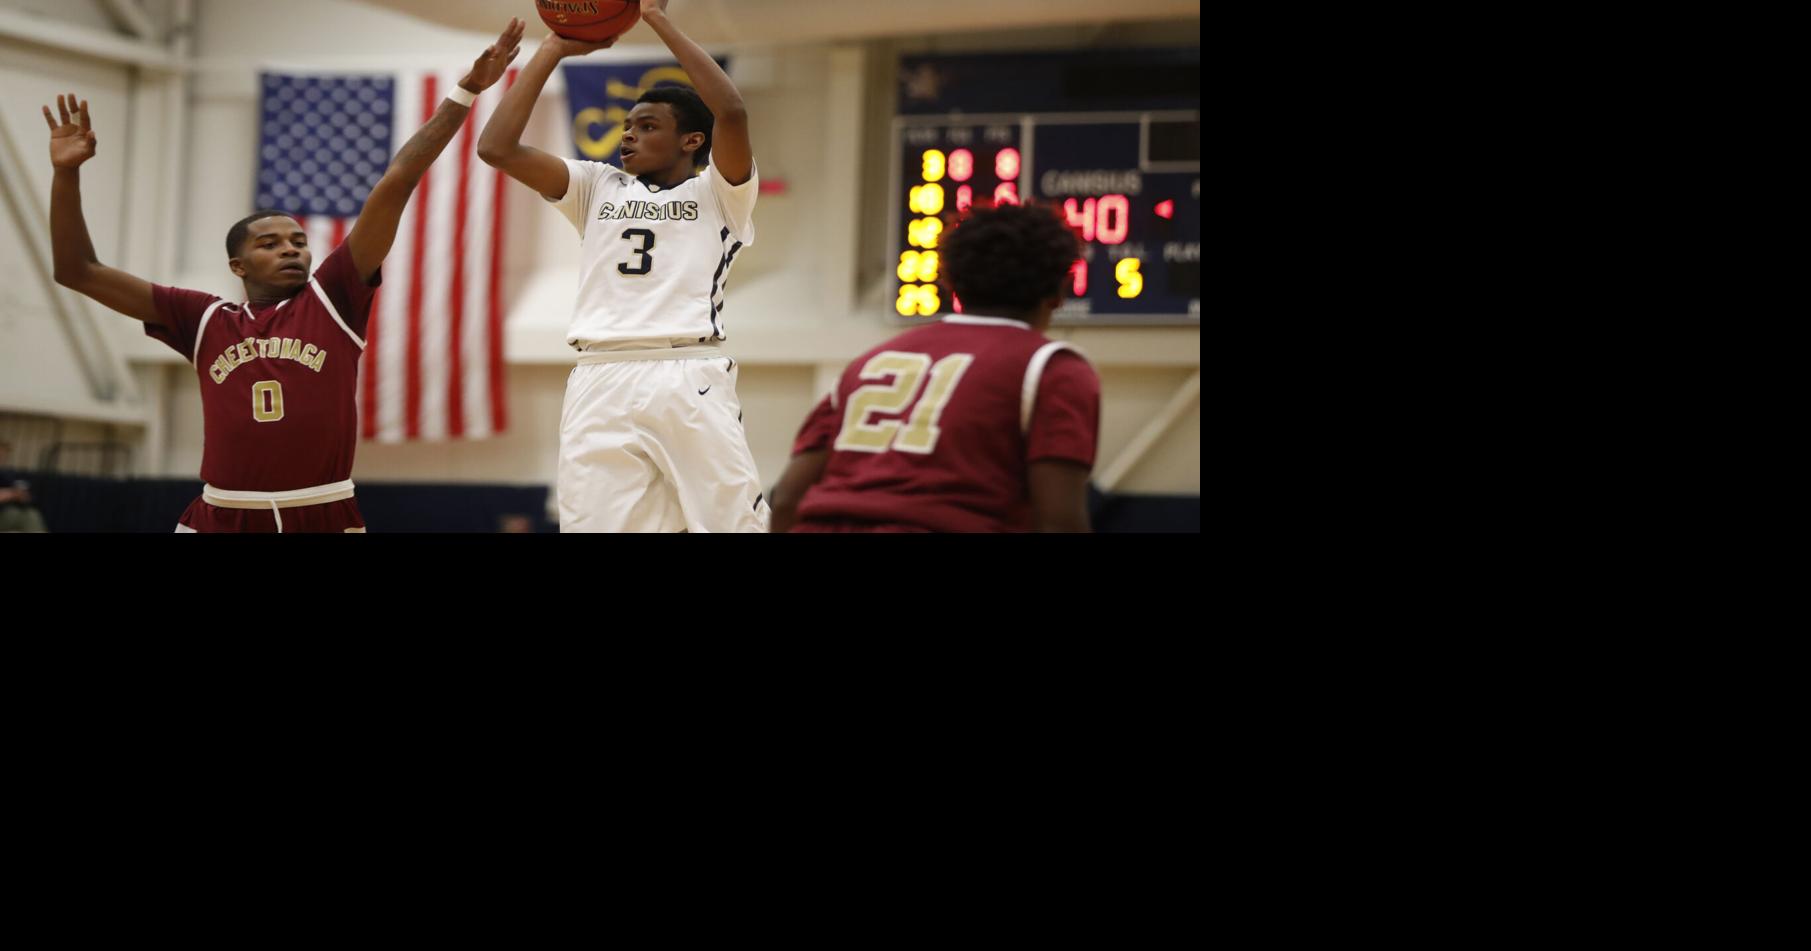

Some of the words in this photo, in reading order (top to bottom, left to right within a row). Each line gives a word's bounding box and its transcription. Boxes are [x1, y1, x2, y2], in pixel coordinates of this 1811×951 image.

[597, 200, 698, 221] CANISIUS
[1064, 194, 1129, 245] 40
[617, 228, 656, 277] 3
[1115, 258, 1143, 298] 5
[252, 380, 284, 422] 0
[834, 350, 974, 454] 21
